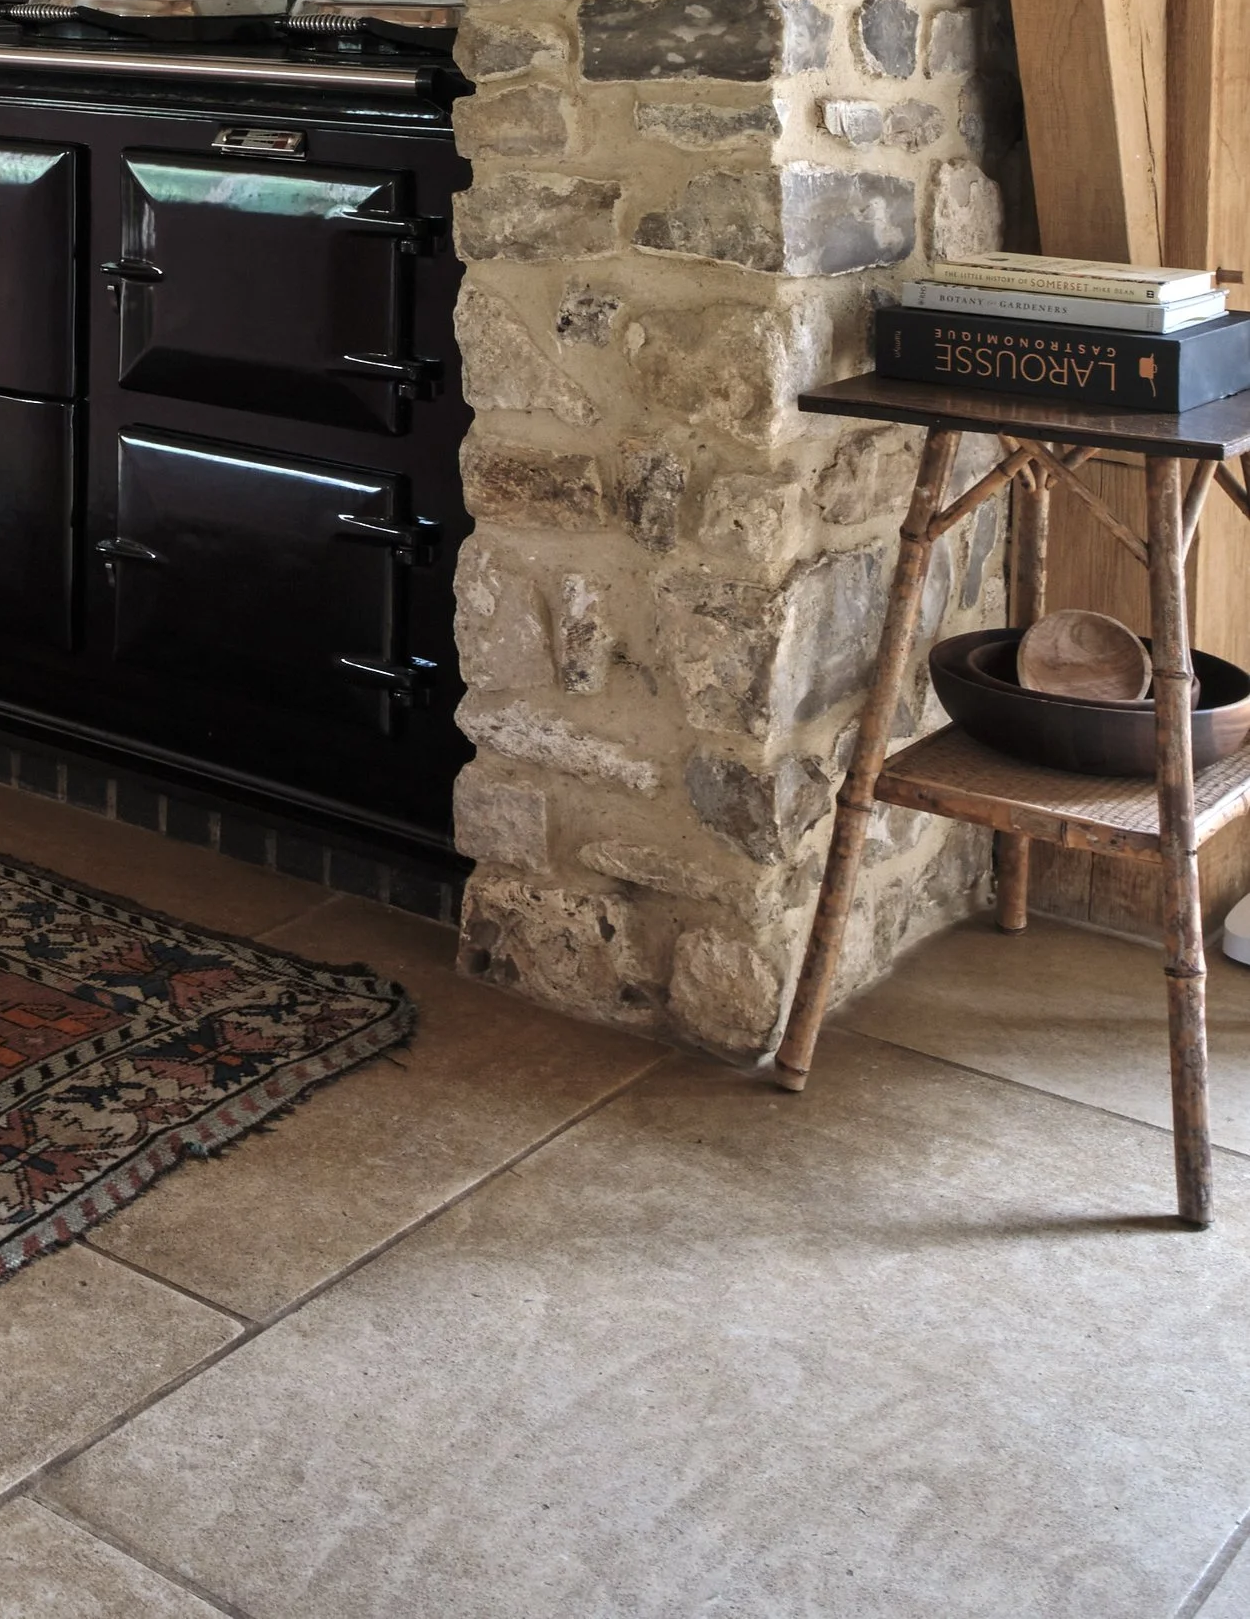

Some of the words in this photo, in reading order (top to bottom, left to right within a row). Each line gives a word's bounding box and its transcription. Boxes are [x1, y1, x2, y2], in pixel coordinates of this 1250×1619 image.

[944, 270, 957, 278] THE
[960, 272, 983, 280] LITTLE
[985, 275, 1015, 283] HISTORY
[1030, 278, 1089, 292] SOMERSET
[1093, 286, 1111, 294] MIKE
[939, 294, 984, 306] BOTANY
[999, 300, 1068, 314] GARDENERS
[934, 328, 1117, 357] GASTRONOMIQUE
[934, 343, 1116, 391] LAROUSSE
